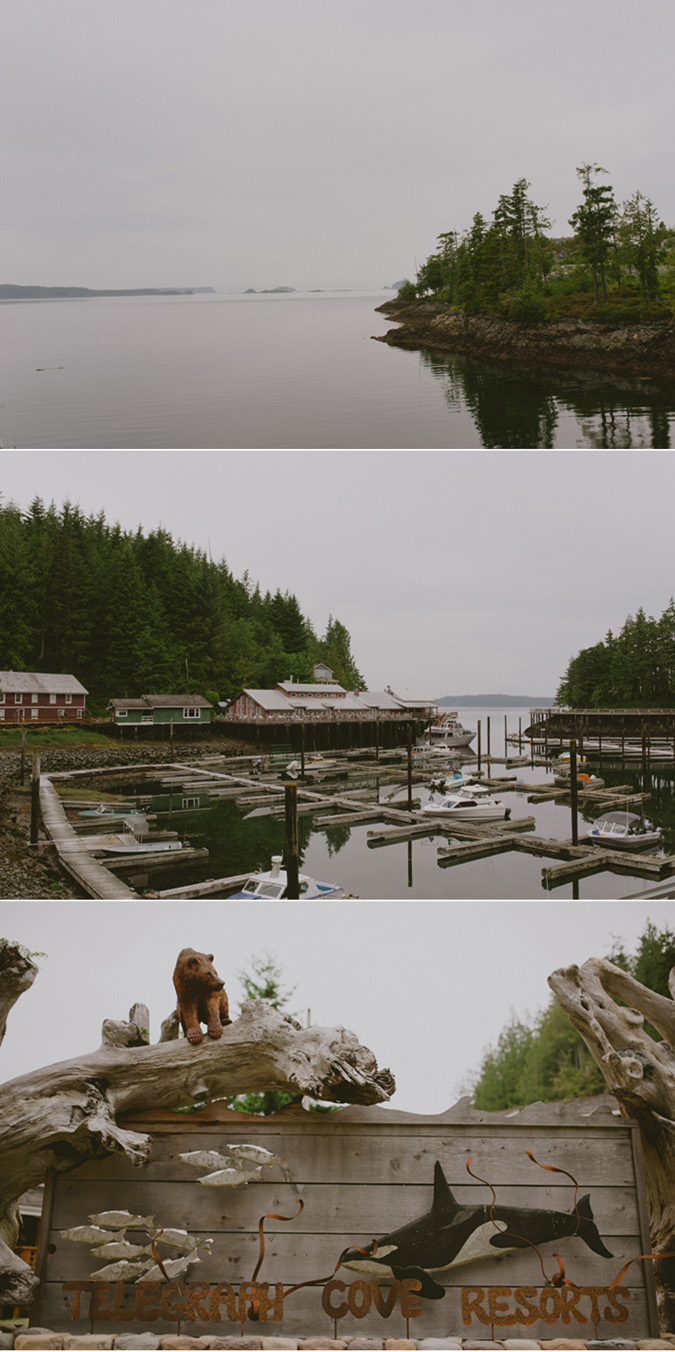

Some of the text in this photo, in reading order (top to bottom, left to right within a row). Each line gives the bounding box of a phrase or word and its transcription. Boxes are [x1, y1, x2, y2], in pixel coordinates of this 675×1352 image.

[62, 1279, 630, 1326] TELEGRAPH COVE RESORTS
